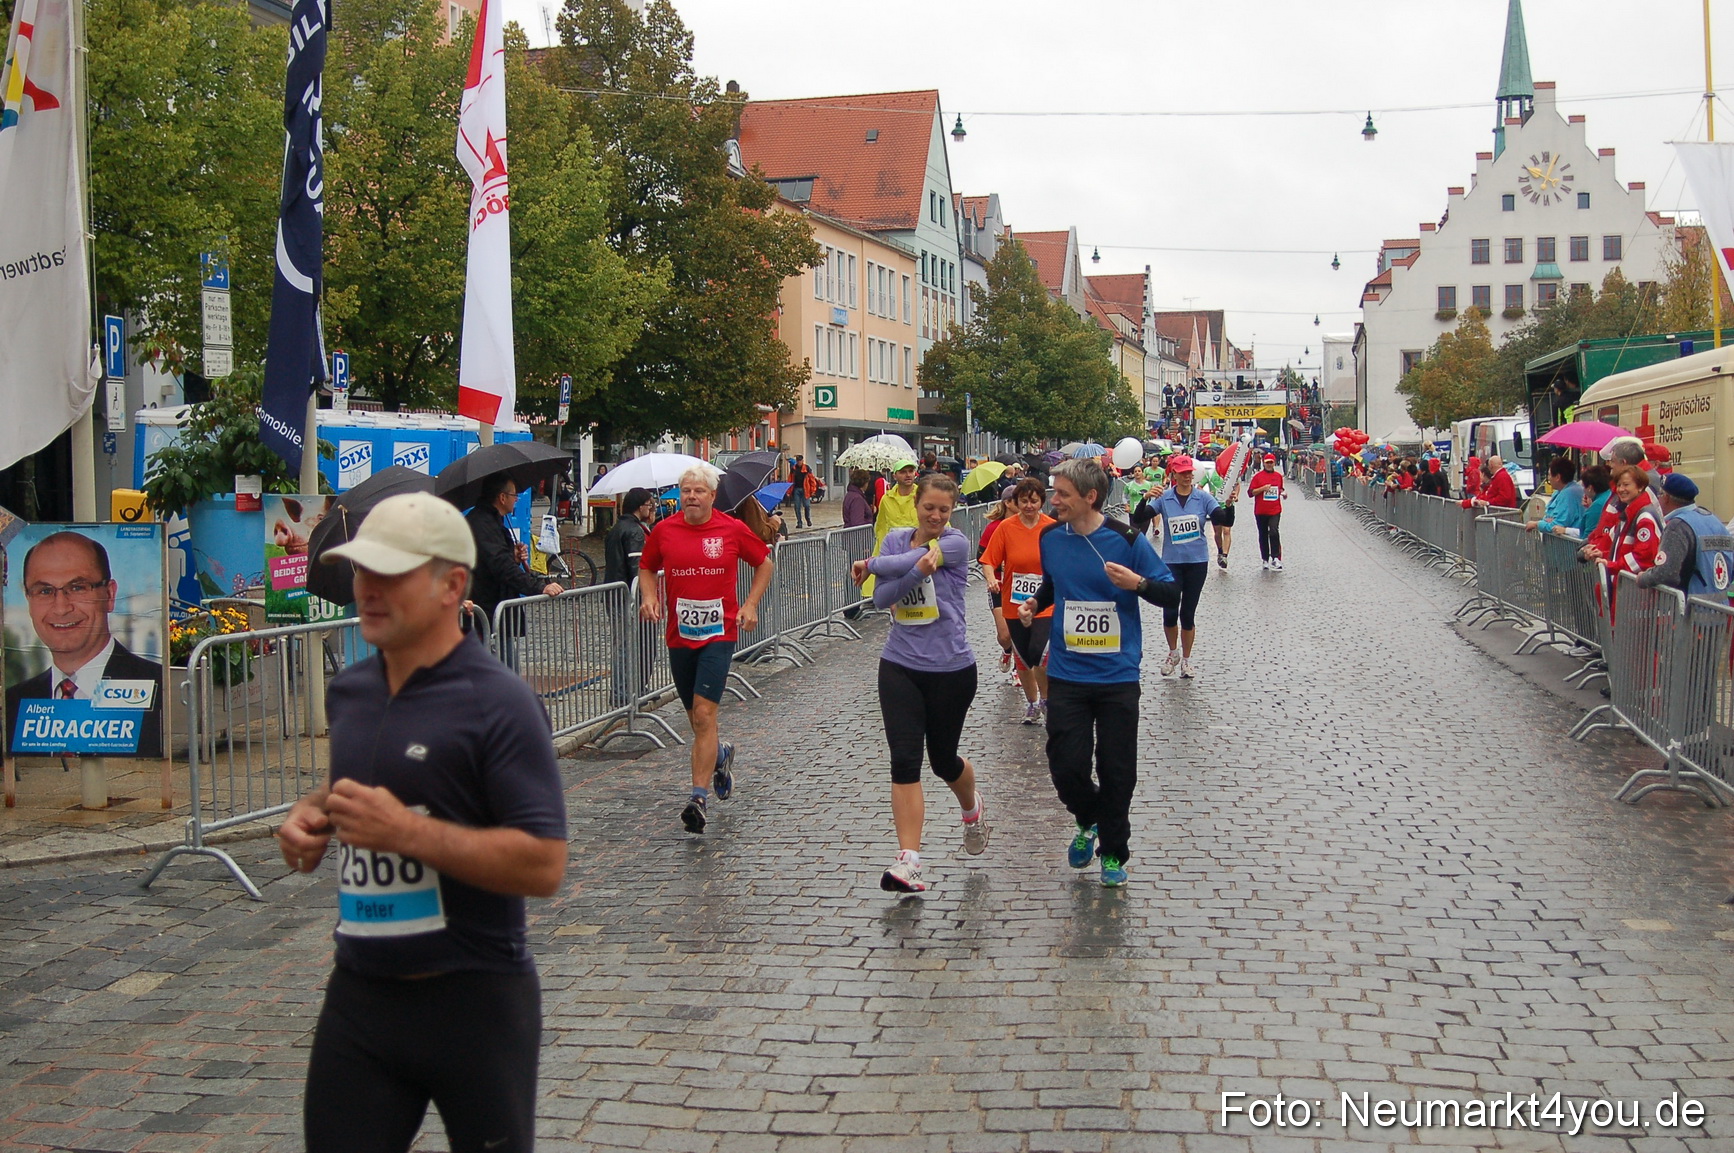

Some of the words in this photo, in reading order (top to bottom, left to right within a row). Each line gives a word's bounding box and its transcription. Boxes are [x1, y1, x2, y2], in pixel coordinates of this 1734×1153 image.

[818, 389, 834, 405] D
[1660, 394, 1711, 422] Bayerisches
[1659, 424, 1683, 443] Rotes
[1172, 520, 1198, 534] 2409
[273, 567, 296, 578] BEIDE
[671, 566, 725, 577] Stadt-Team
[681, 609, 719, 626] 2378
[1075, 614, 1110, 633] 266
[1076, 637, 1107, 646] Michael
[103, 688, 132, 699] CSU
[26, 704, 55, 714] Albert
[22, 715, 135, 738] FÜRACKER
[356, 900, 395, 918] Peter
